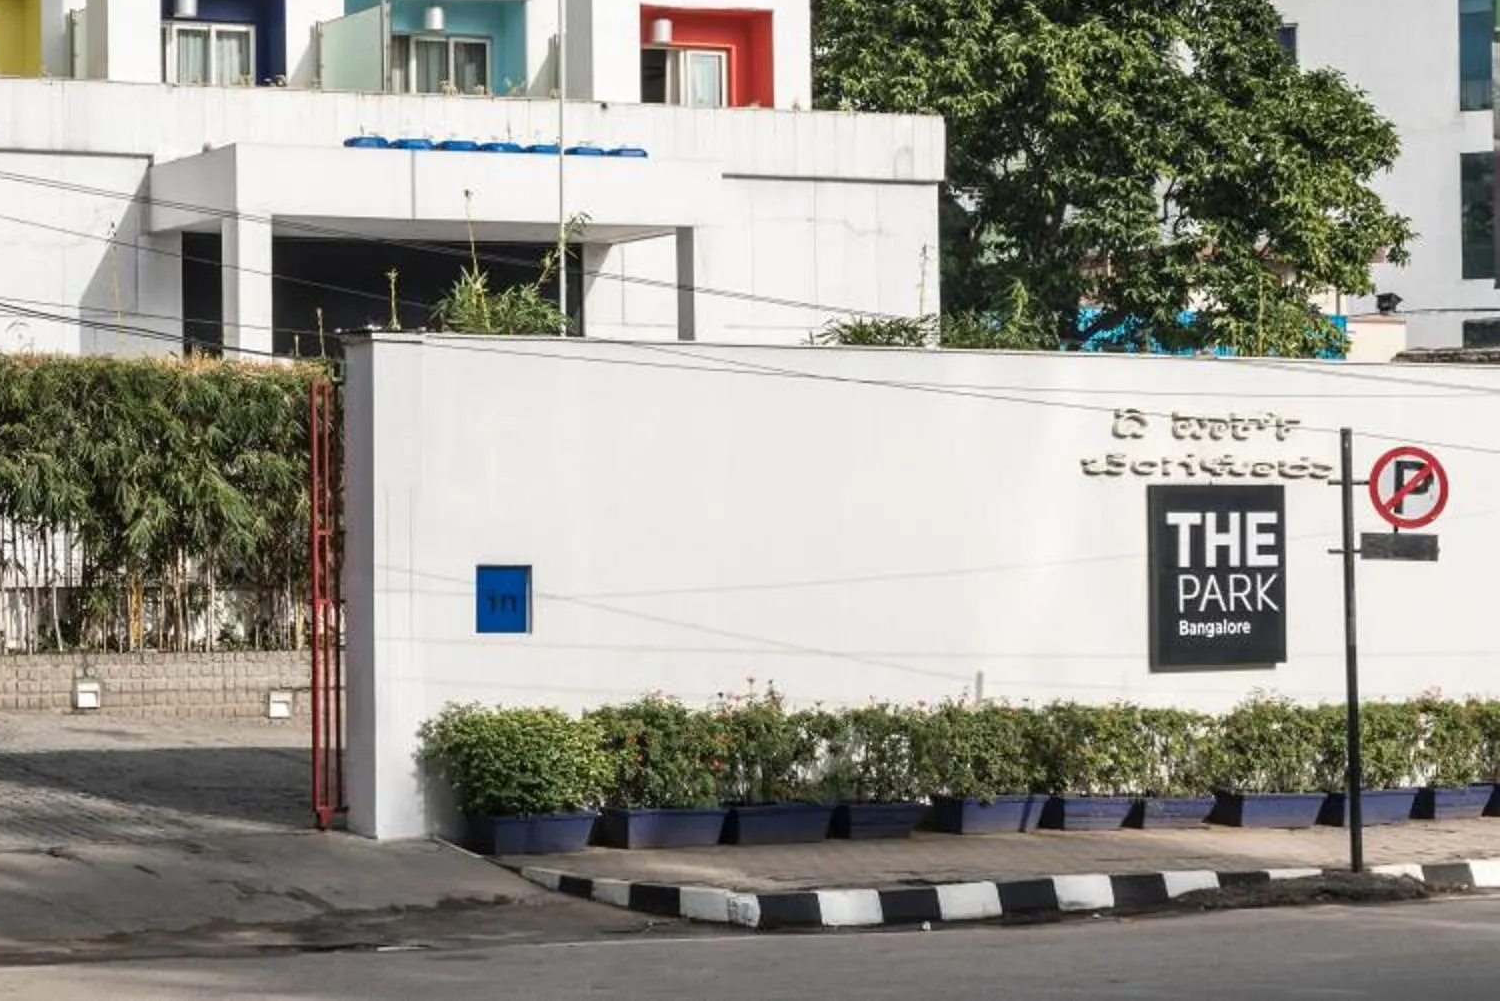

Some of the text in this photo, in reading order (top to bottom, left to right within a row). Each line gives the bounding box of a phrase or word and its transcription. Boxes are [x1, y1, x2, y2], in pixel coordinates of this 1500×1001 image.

[1166, 511, 1279, 568] THE
[1178, 572, 1280, 613] PARK
[1179, 618, 1251, 638] Bangalore
